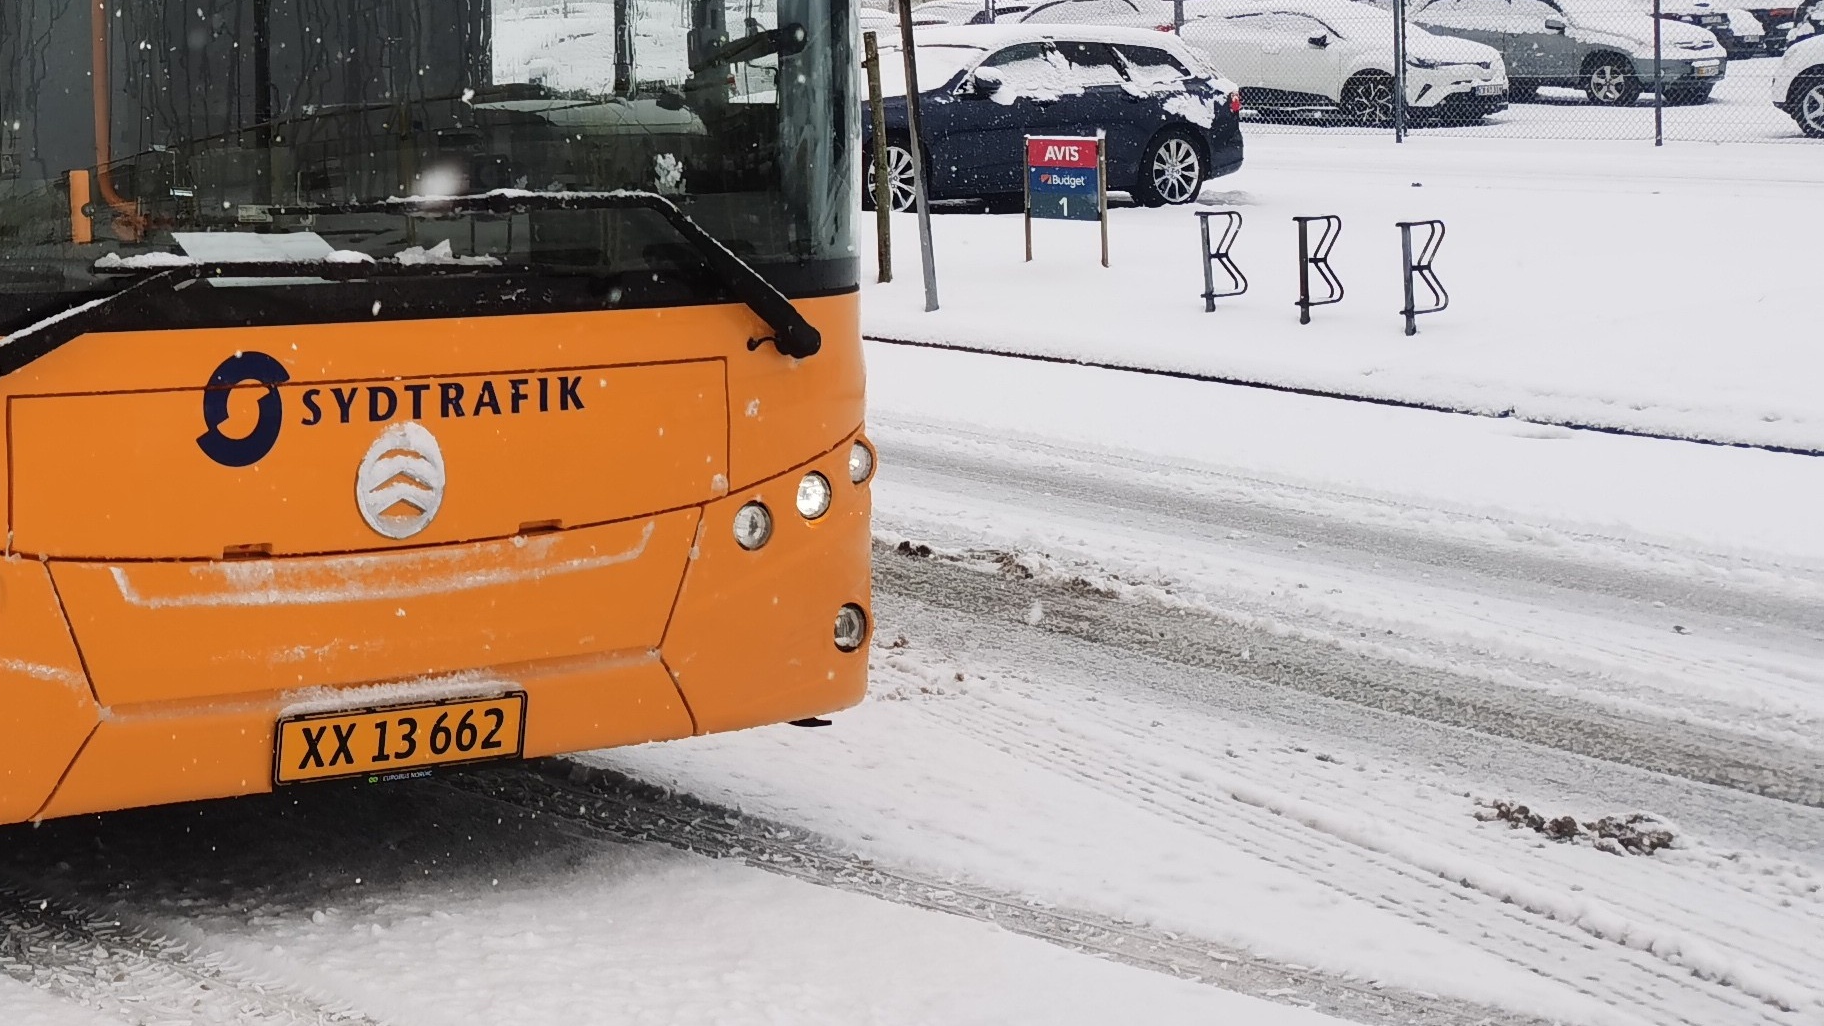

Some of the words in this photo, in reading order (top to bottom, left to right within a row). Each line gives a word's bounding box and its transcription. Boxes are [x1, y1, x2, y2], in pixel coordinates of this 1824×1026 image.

[1044, 145, 1079, 161] AVIS
[1052, 174, 1085, 189] Budget
[1058, 196, 1068, 217] 1
[301, 376, 585, 425] SYDTRAFIK
[299, 723, 357, 770] XX
[371, 717, 418, 763] 13
[429, 708, 505, 756] 662
